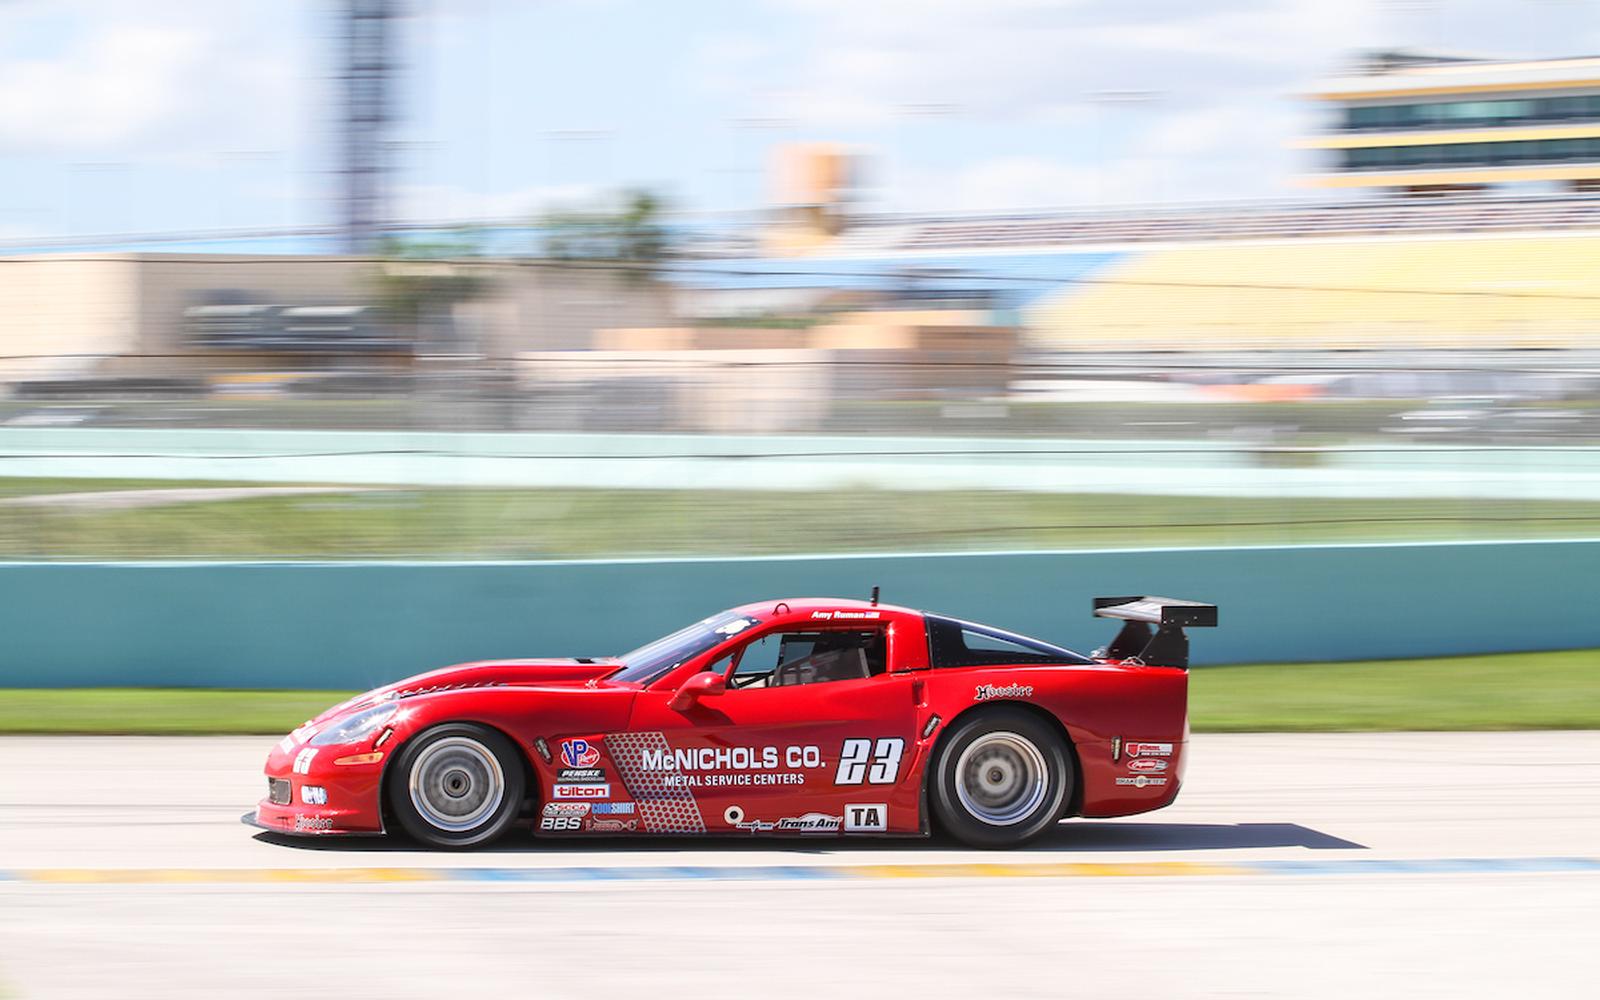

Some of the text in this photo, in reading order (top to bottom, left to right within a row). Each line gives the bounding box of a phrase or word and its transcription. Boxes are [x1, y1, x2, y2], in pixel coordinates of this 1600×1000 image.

[811, 611, 865, 621] Amy Ruman
[974, 682, 1033, 700] Hoosier
[561, 739, 588, 767] VP
[642, 746, 826, 772] McNICHOLS CO.
[834, 738, 905, 785] 23
[561, 769, 601, 777] PENSKE
[664, 773, 805, 787] METAL SERVICE CENTERS
[557, 786, 606, 797] tilton
[541, 817, 582, 830] BBS
[780, 818, 839, 829] Trans Am
[850, 808, 881, 827] TA
